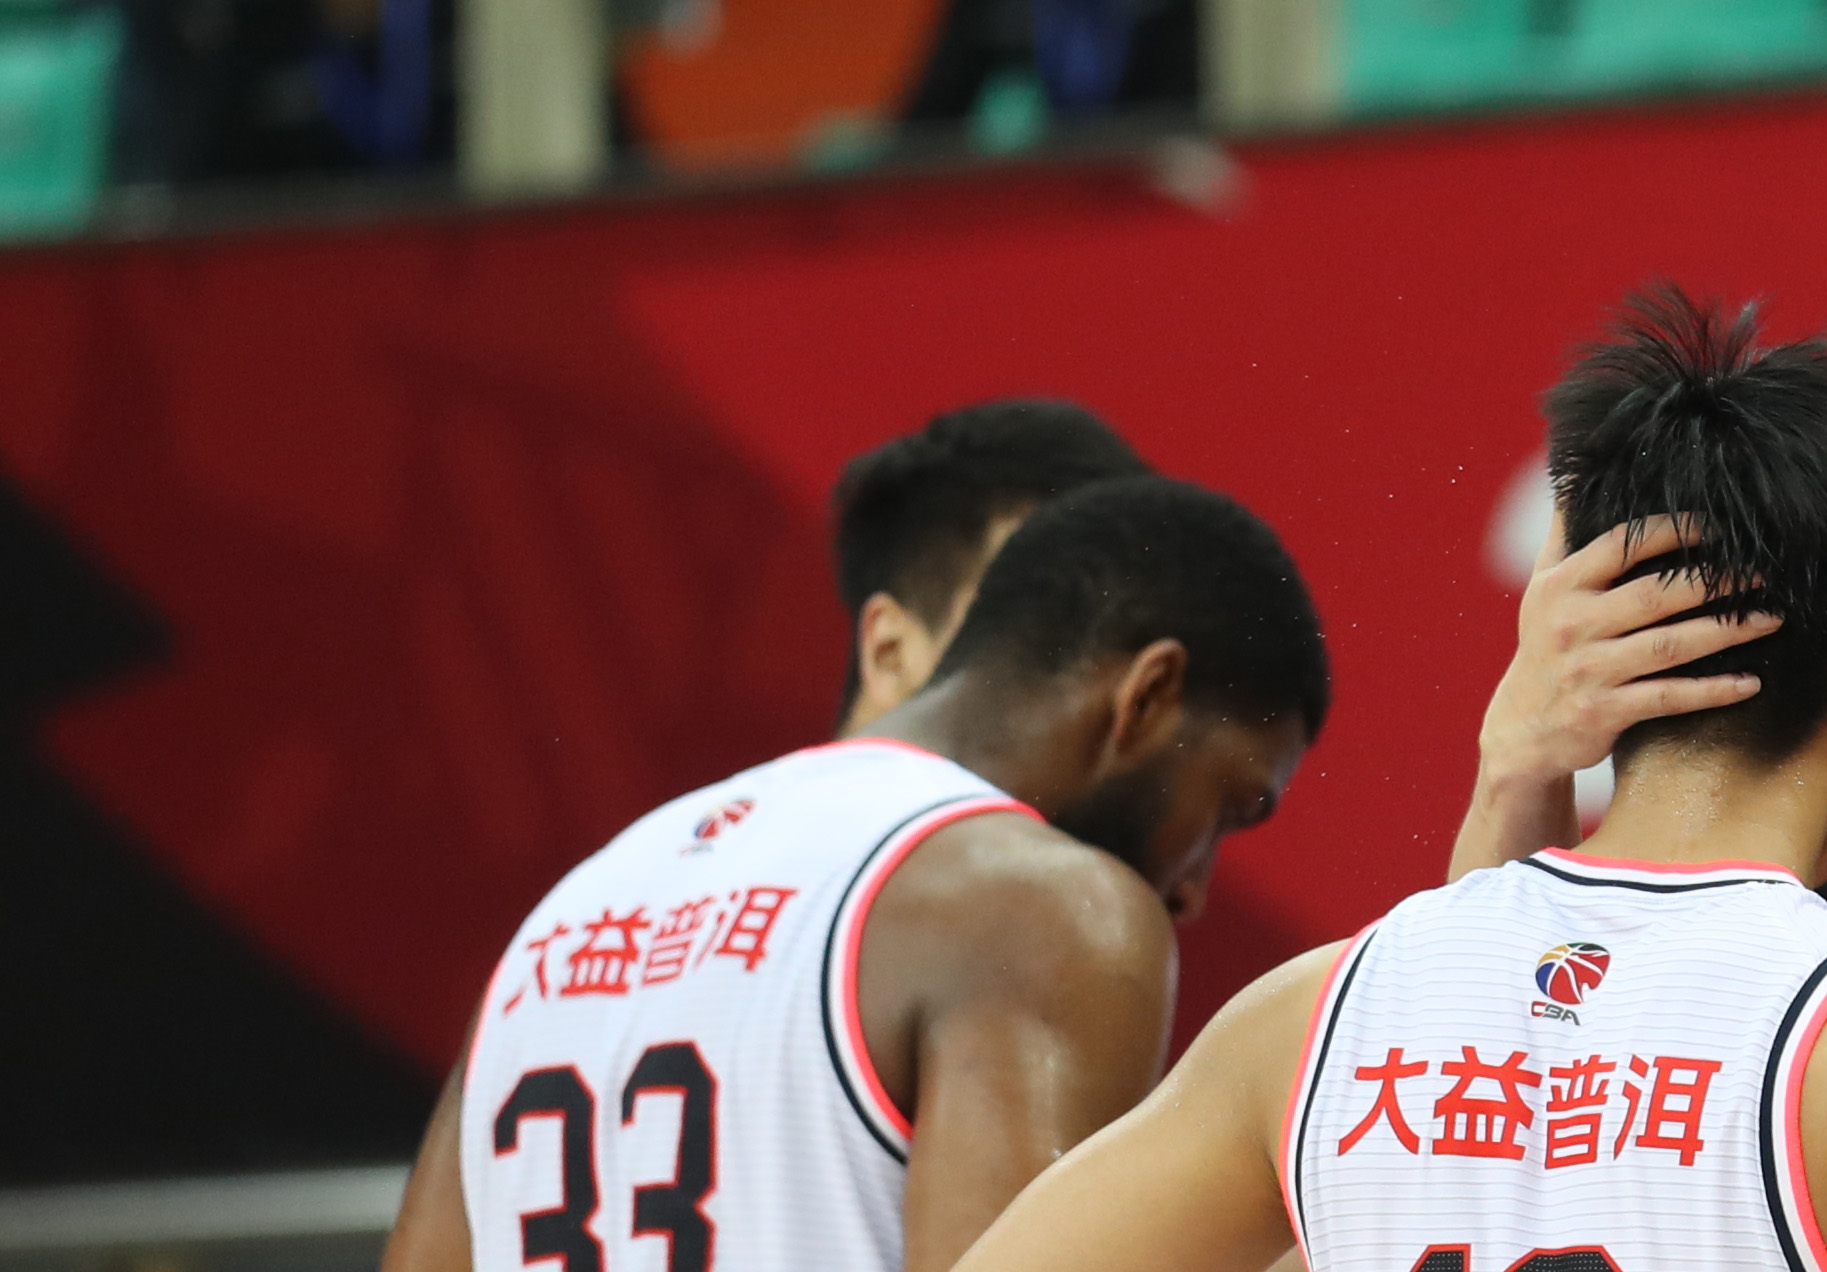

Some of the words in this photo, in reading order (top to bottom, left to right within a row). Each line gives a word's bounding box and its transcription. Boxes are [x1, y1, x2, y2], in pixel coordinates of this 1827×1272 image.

[1531, 1001, 1581, 1027] CBA
[1338, 1045, 1722, 1170] 大益普洱
